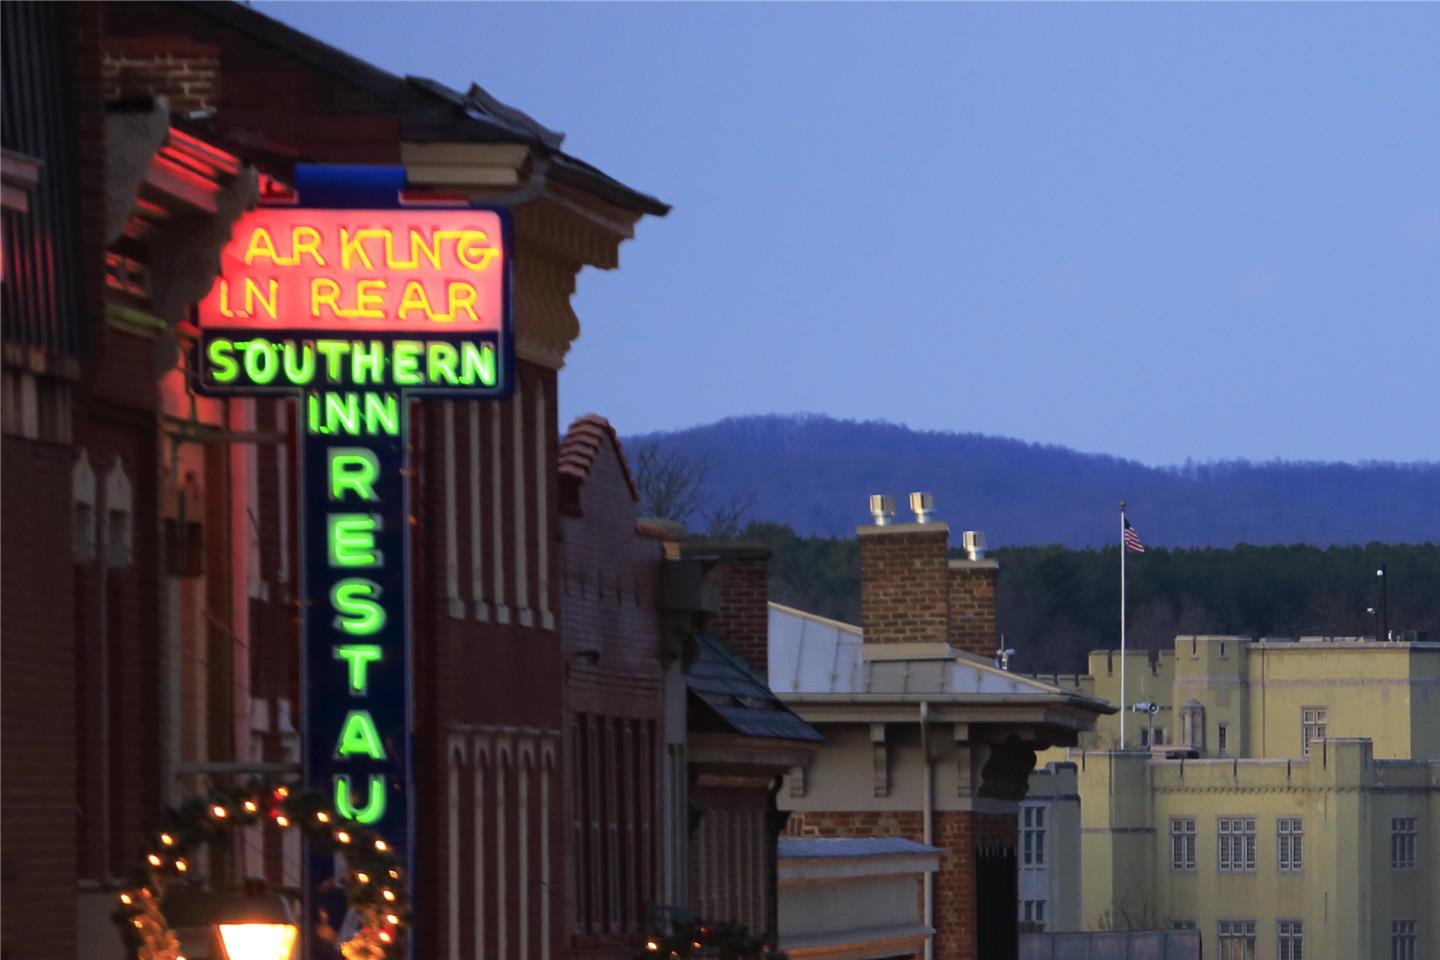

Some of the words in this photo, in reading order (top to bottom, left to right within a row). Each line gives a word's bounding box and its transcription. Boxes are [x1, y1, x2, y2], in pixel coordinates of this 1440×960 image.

[244, 226, 499, 272] ARKING
[218, 277, 279, 320] IN
[311, 278, 479, 323] REAR
[208, 336, 497, 387] SOUTHERN
[307, 390, 400, 436] INN
